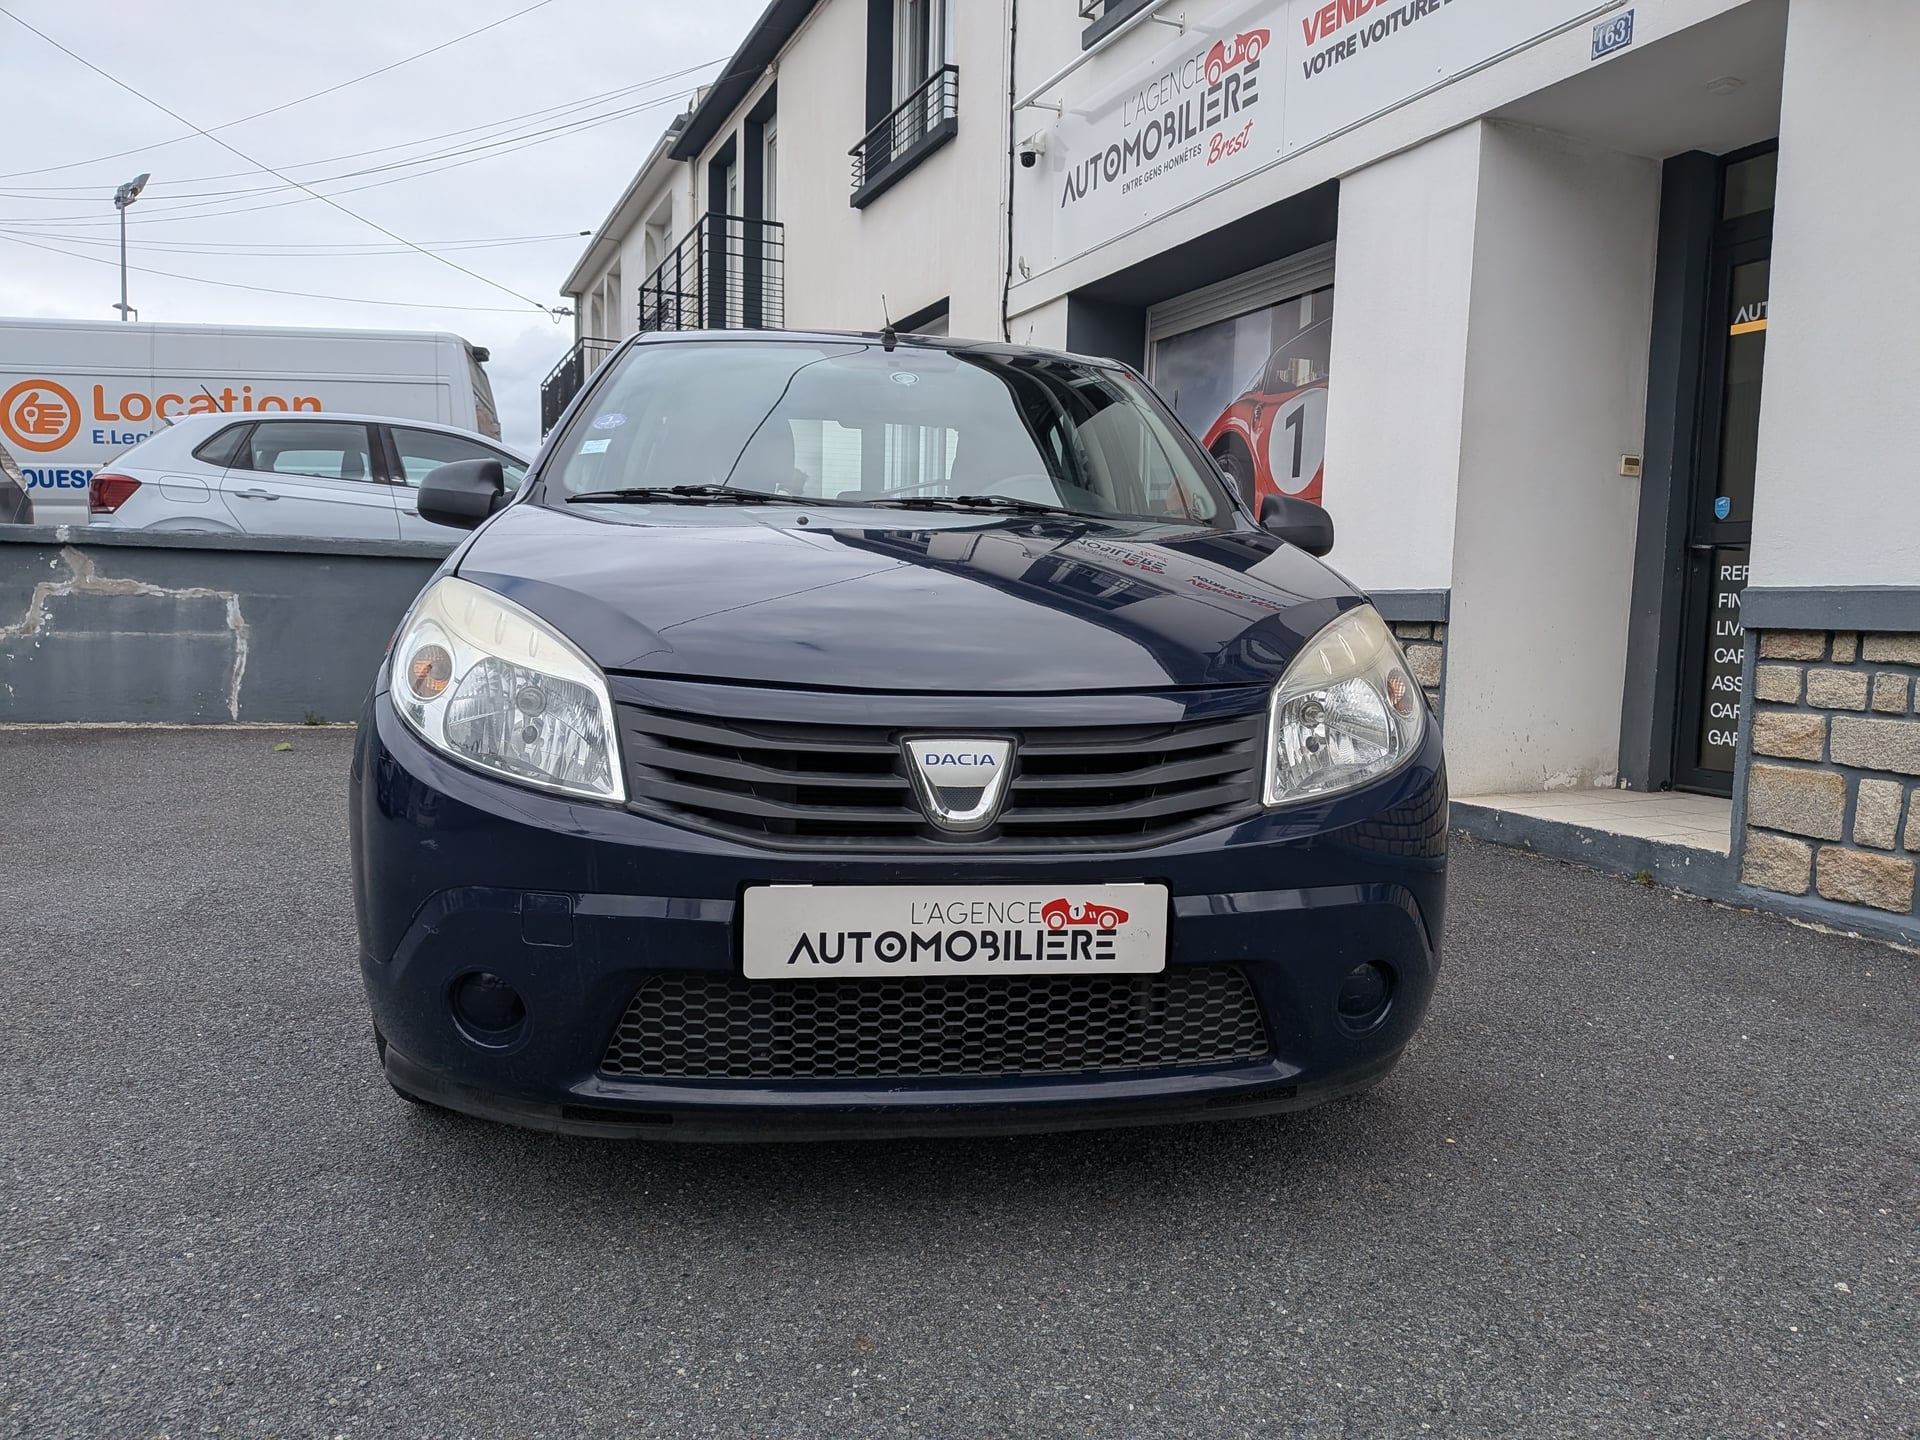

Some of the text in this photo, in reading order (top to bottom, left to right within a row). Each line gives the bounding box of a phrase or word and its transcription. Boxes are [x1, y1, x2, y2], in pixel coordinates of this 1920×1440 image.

[1303, 0, 1440, 79] VOTRE VOITURE
[1597, 20, 1626, 50] 163
[1123, 51, 1205, 128] L'AGENCE
[1207, 119, 1253, 166] Brest
[1122, 144, 1202, 194] ENTRE GENS HONNÊTES
[93, 385, 322, 422] Location
[1285, 403, 1305, 479] 1
[925, 753, 995, 767] DACIA
[911, 901, 1041, 925] L'AGENCE
